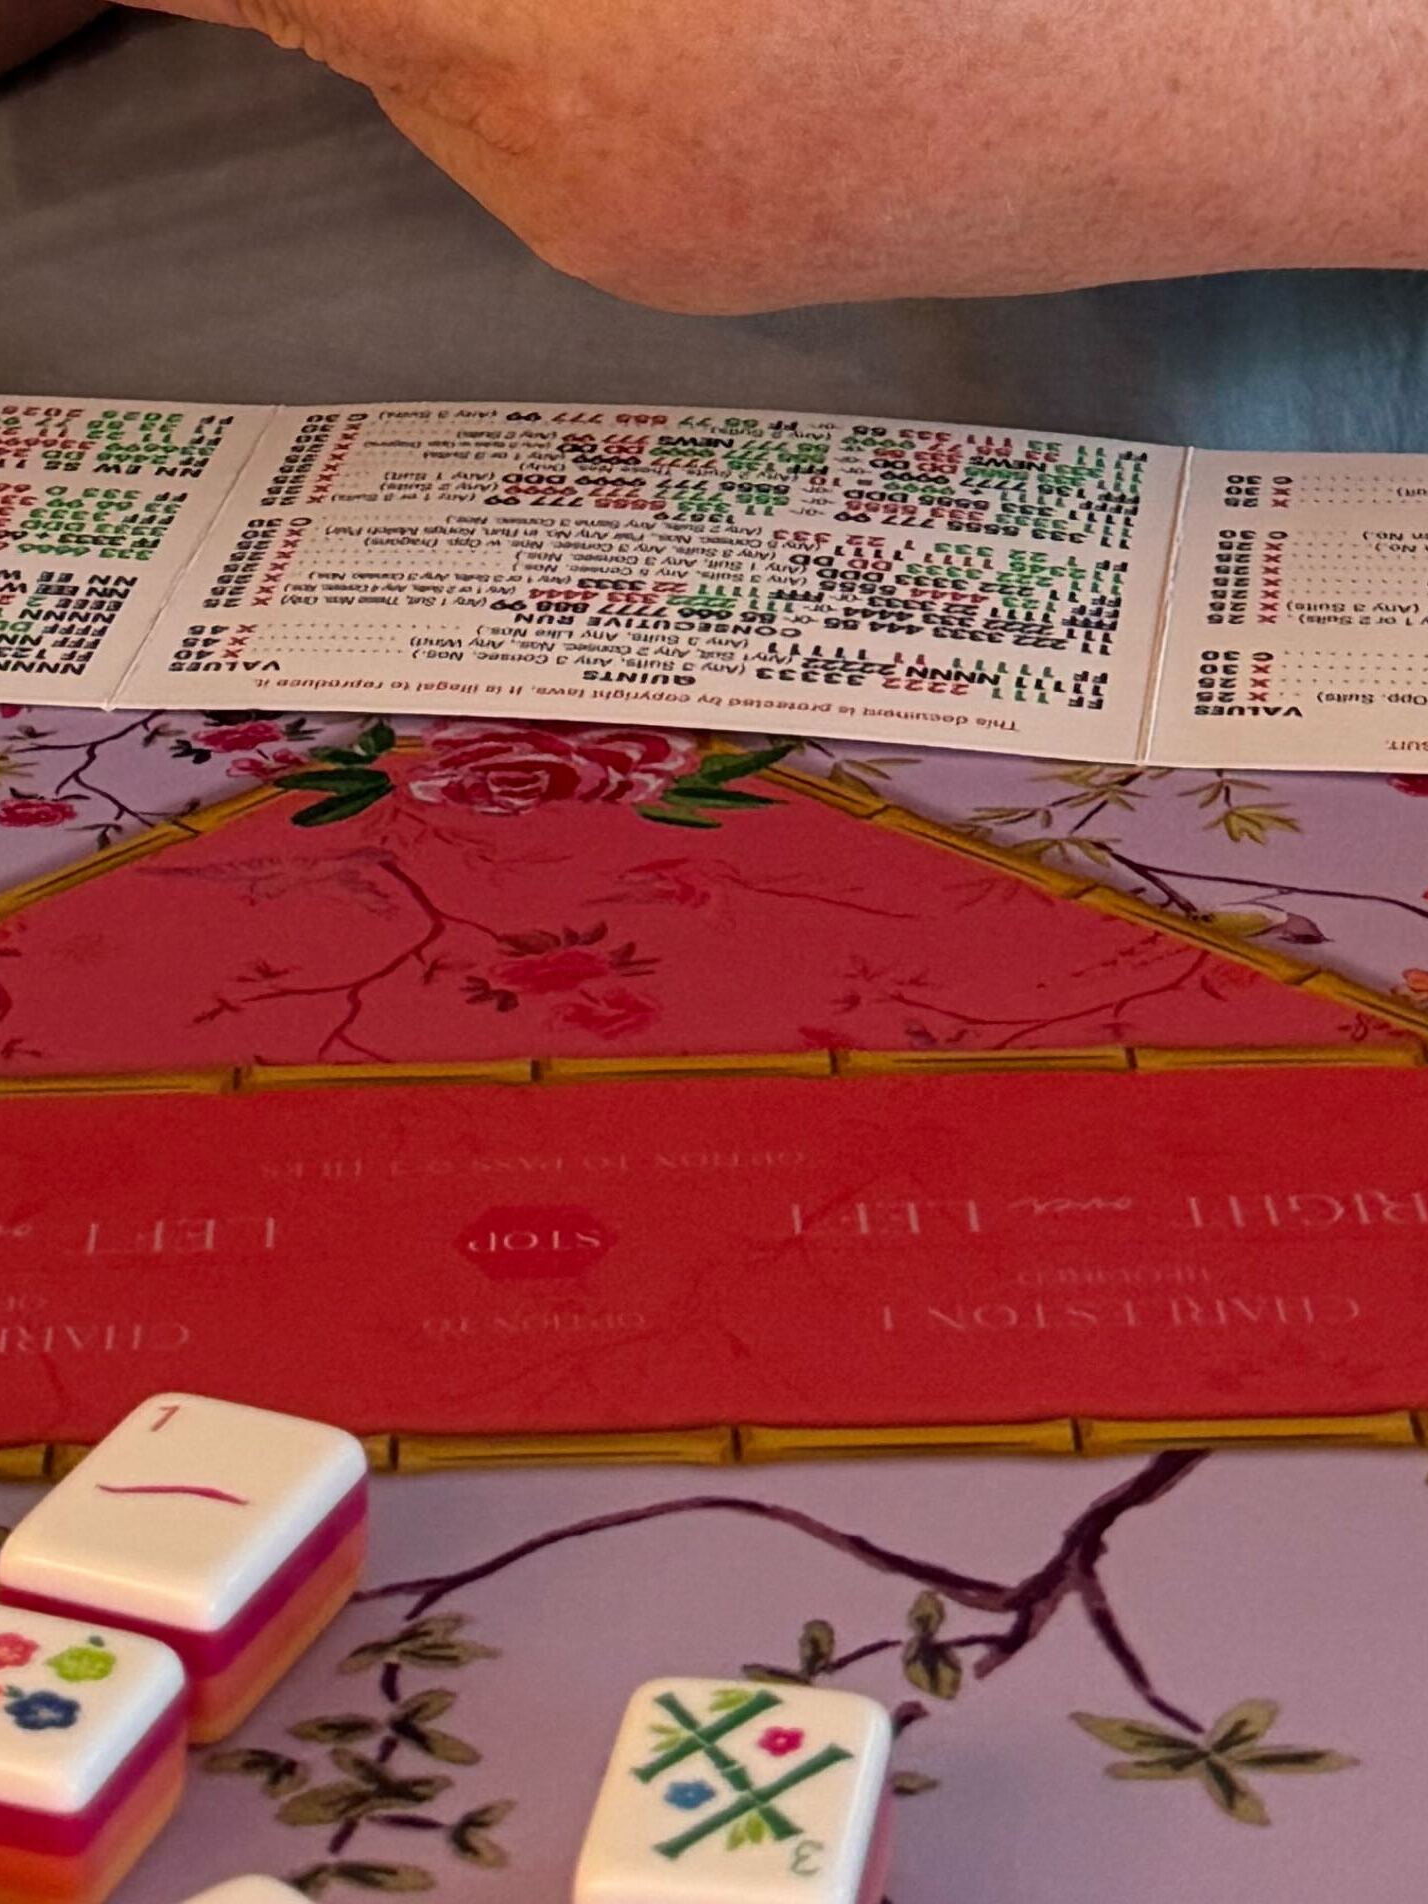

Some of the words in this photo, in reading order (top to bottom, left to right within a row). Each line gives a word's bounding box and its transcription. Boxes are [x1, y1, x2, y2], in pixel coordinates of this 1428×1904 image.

[513, 614, 574, 625] RUN
[42, 624, 109, 637] FFFF
[587, 616, 802, 638] CONSECUTIVE
[174, 649, 214, 660] 40
[223, 649, 243, 658] X
[1201, 651, 1240, 661] 30
[1252, 652, 1274, 662] C
[168, 660, 280, 672] VALUES
[1200, 664, 1238, 674] 30
[1251, 664, 1272, 674] X
[583, 670, 696, 686] QUINTS
[755, 667, 865, 686] 33333
[1198, 677, 1237, 688] 25
[276, 679, 384, 690] reproduce
[390, 681, 410, 691] to
[415, 682, 479, 695] illegal
[881, 678, 969, 696] 2222
[1250, 678, 1271, 688] X
[485, 685, 502, 694] is
[506, 686, 523, 695] It
[591, 690, 690, 704] copyright
[697, 694, 722, 706] by
[992, 688, 1049, 704] 111
[1196, 692, 1235, 702] 25
[1249, 692, 1270, 702] X
[1381, 693, 1428, 705] Opp.
[730, 697, 832, 713] protected
[1068, 697, 1103, 710] FF
[839, 706, 856, 715] is
[1194, 705, 1302, 717] VALUES
[863, 708, 968, 726] document
[976, 717, 1018, 731] This
[1008, 1196, 1132, 1216] over
[783, 1200, 980, 1236] LEFT
[64, 1216, 276, 1255] LEFT
[466, 1229, 602, 1253] STOP
[926, 1295, 1361, 1330] CHARLESTON
[151, 1404, 181, 1432] 1
[789, 1839, 823, 1876] 3
